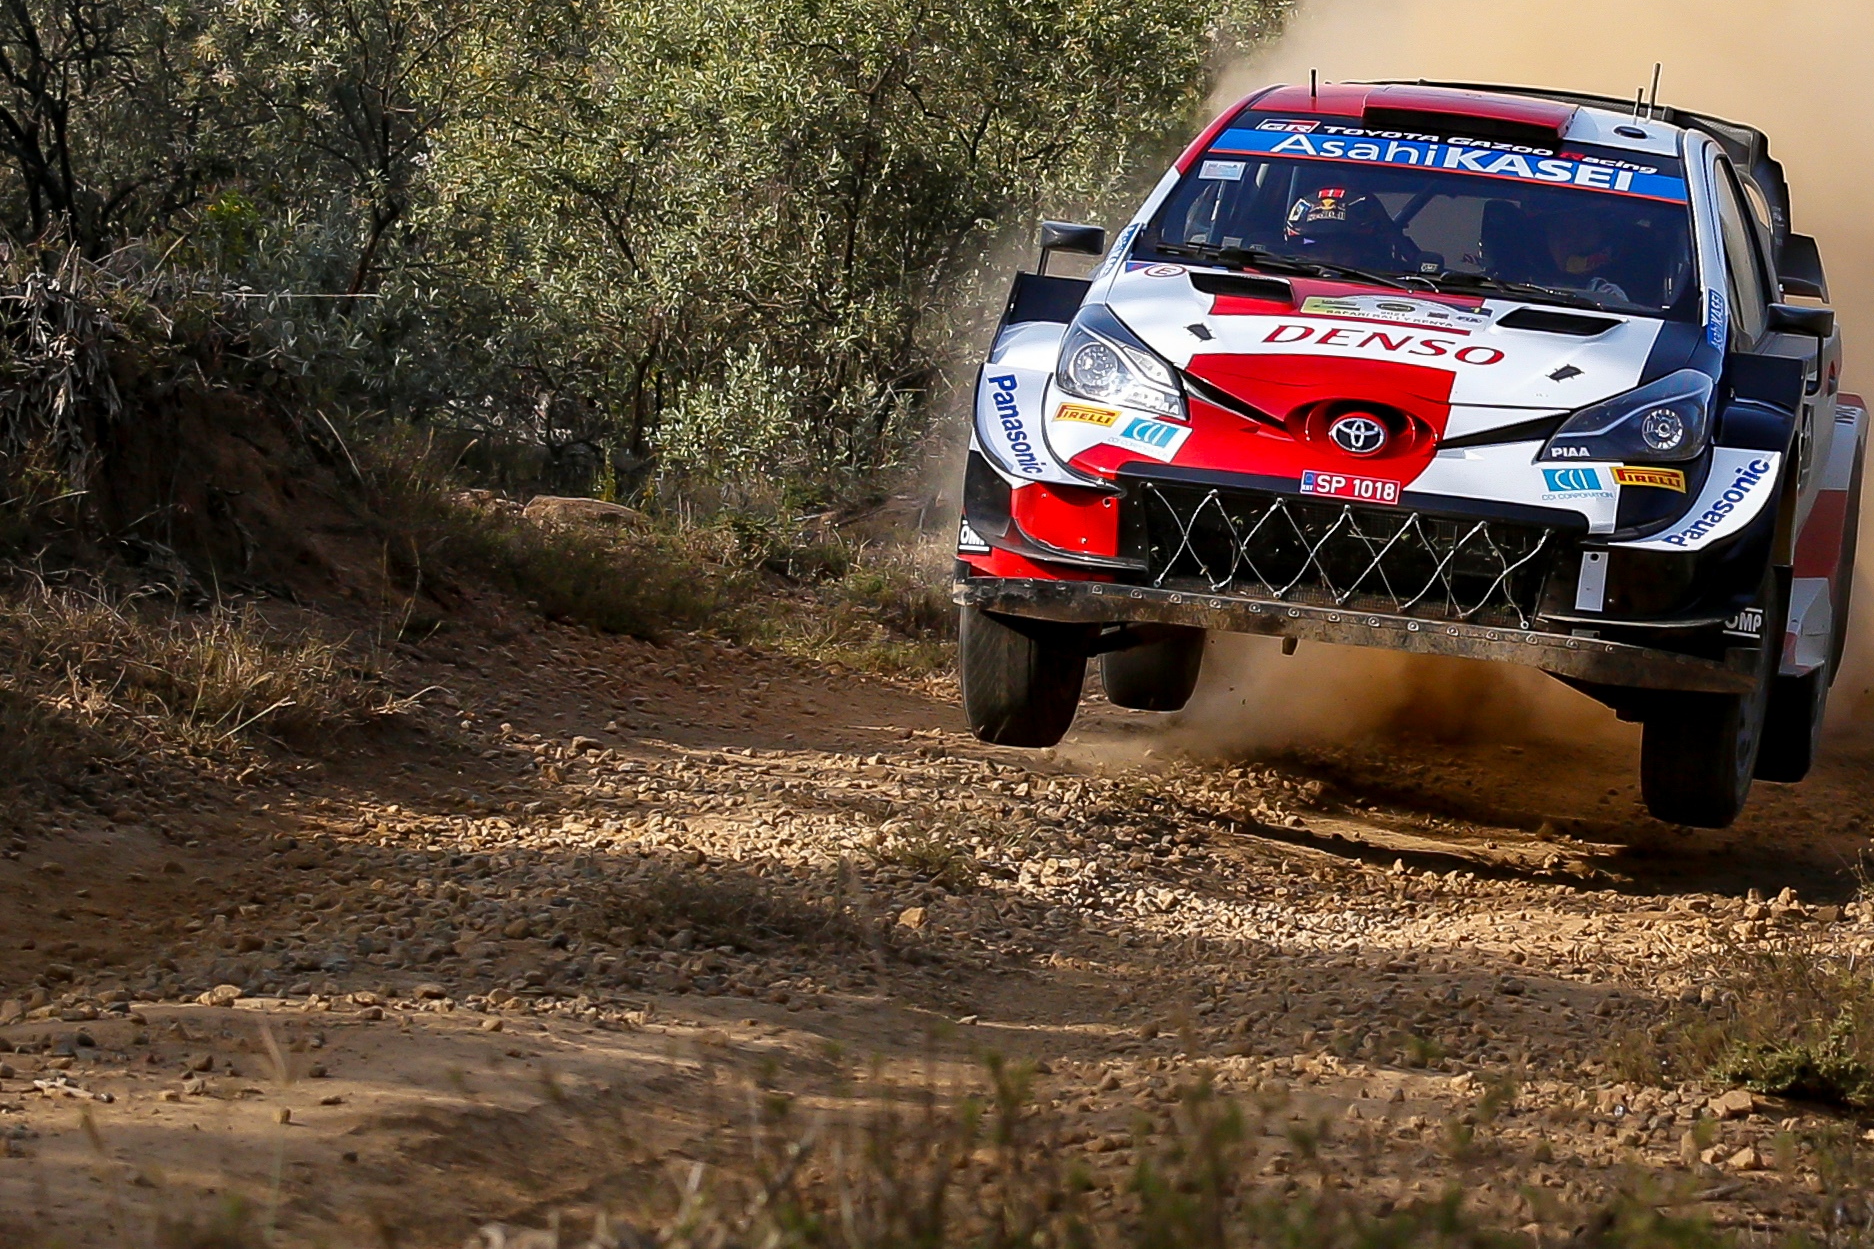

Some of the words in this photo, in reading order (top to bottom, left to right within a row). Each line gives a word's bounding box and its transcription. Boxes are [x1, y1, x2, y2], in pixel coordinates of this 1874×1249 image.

[1269, 133, 1635, 192] AsahiKASEI
[1323, 125, 1440, 142] TOYOTA
[1446, 136, 1554, 157] GAZOO
[1558, 150, 1658, 174] Racing
[1261, 324, 1506, 366] DENSO
[987, 374, 1047, 474] Panasonic
[1056, 404, 1116, 424] PIRELLI
[1551, 446, 1591, 457] PIAA
[1316, 474, 1347, 494] SP
[1353, 479, 1395, 501] 1018
[1615, 468, 1681, 488] PIRELLI
[1662, 458, 1770, 547] Panasonic
